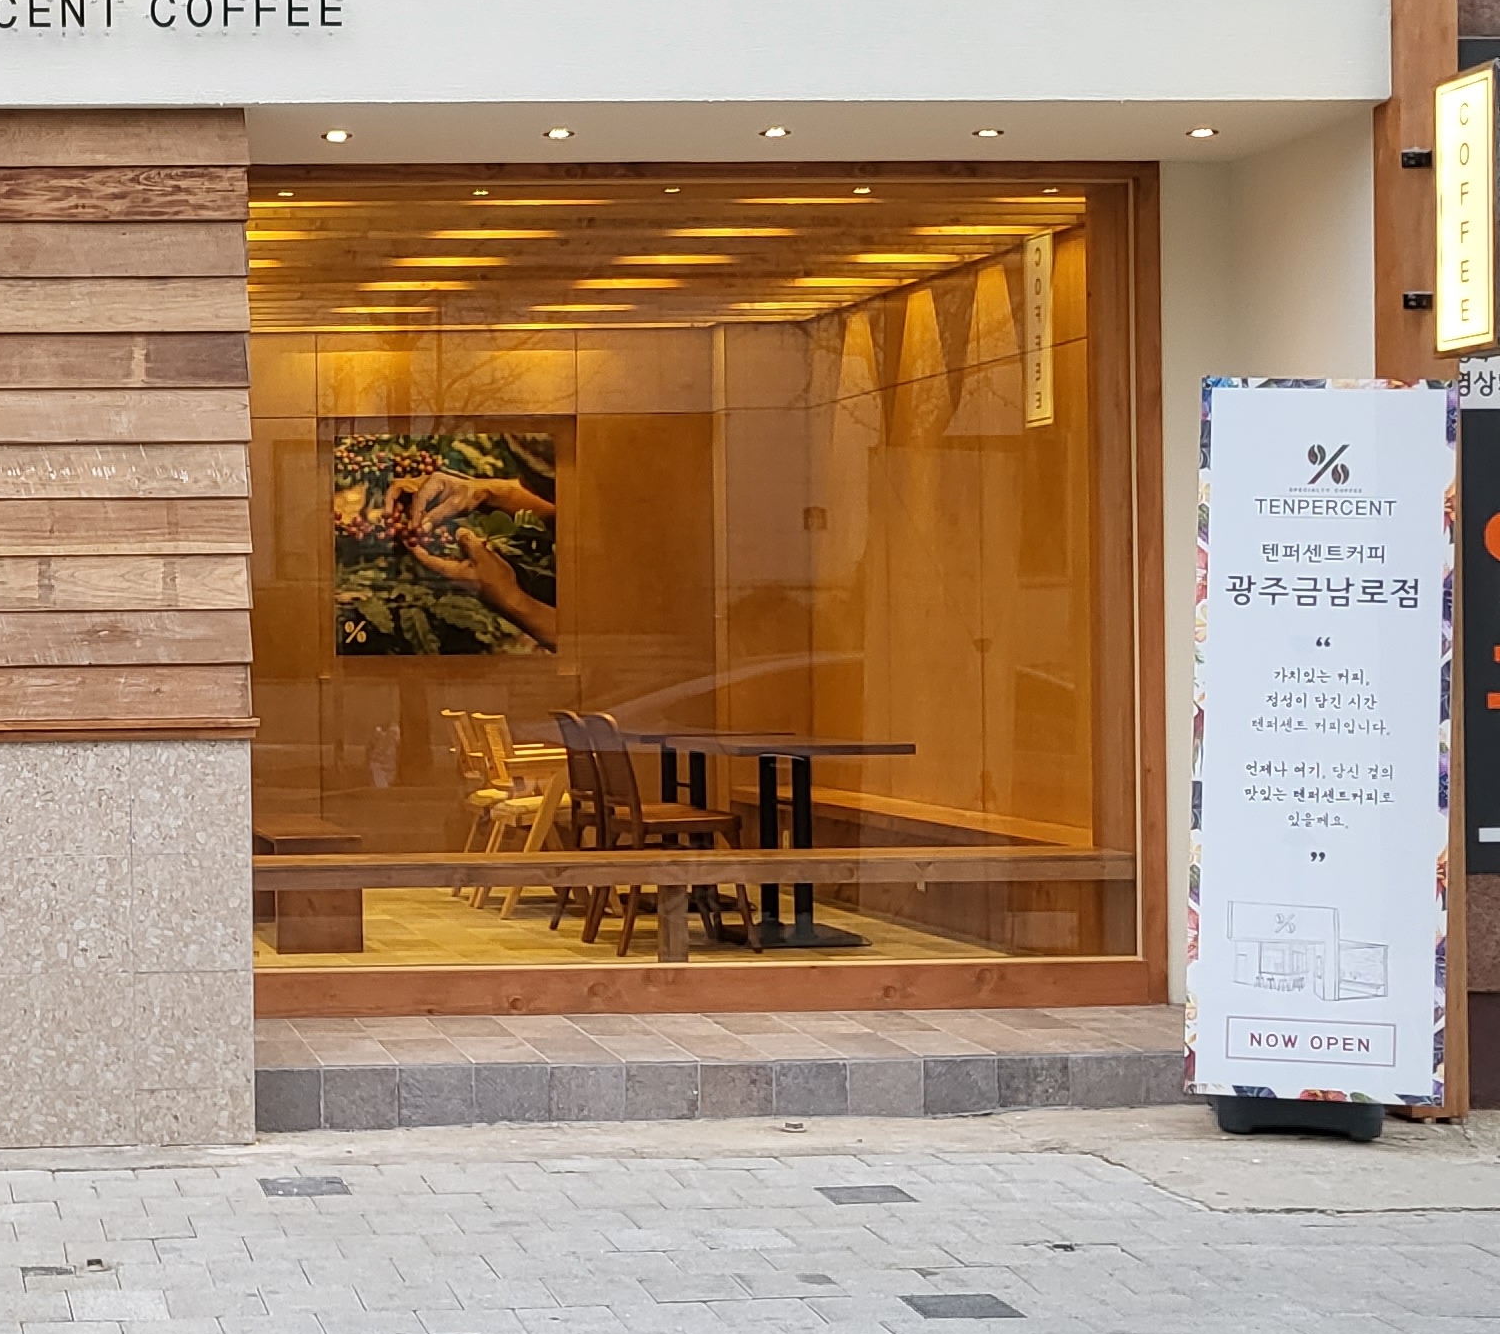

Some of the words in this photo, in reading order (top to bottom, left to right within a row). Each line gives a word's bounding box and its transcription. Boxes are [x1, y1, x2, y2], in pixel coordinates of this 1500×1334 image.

[1459, 101, 1470, 322] COFFEE
[1459, 370, 1500, 397] 영상
[1254, 498, 1397, 516] TENPERCENT
[1261, 543, 1386, 564] 텐퍼센트커피
[1224, 574, 1420, 609] 광주금남로점
[1274, 667, 1332, 684] 가치있는
[1266, 691, 1307, 709] 정성이
[1314, 693, 1341, 709] 담긴
[1348, 694, 1378, 710] 시간
[1251, 716, 1308, 733] 텐퍼센트
[1314, 718, 1391, 736] 커피입니다.
[1245, 760, 1288, 778] 언제나
[1332, 763, 1359, 779] 당신
[1244, 785, 1287, 802] 맛있는
[1293, 787, 1395, 805] 텐퍼센트커피로
[1249, 1031, 1299, 1049] NOW
[1309, 1033, 1372, 1053] OPEN
